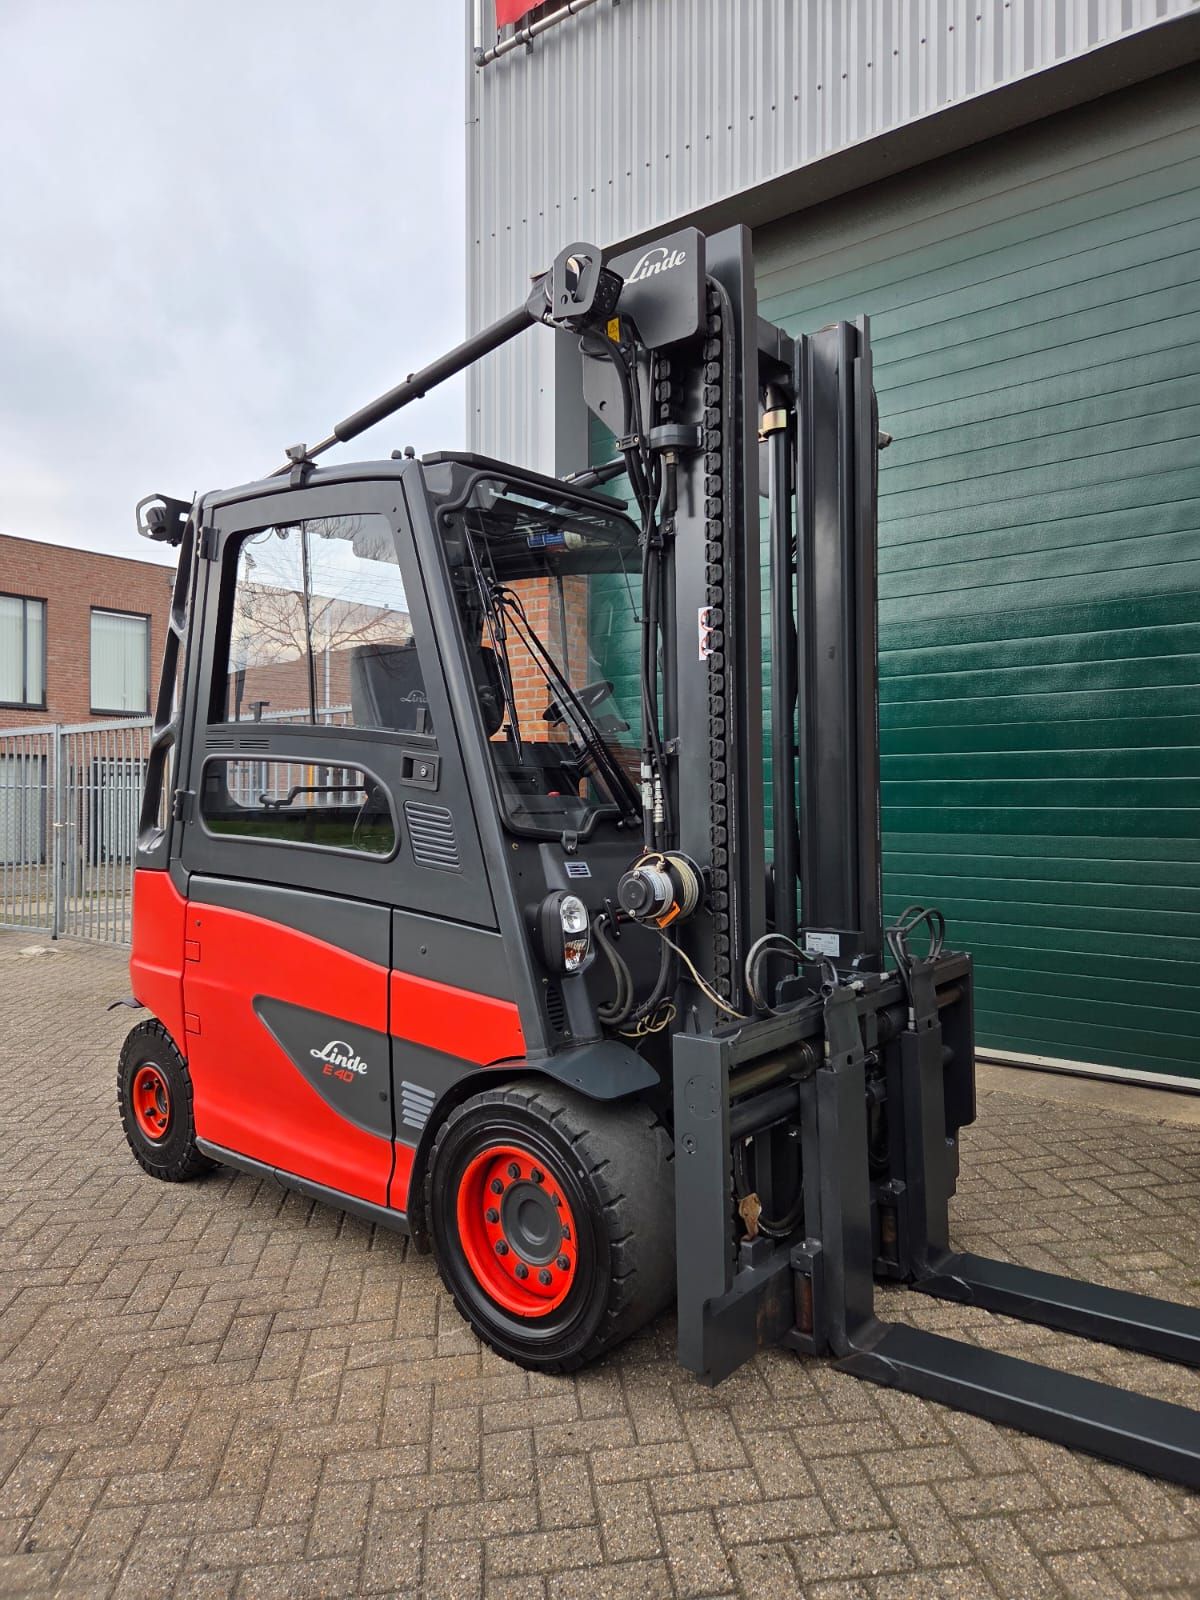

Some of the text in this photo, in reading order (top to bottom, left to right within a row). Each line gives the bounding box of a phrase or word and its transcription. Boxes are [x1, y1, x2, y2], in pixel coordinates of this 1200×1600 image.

[623, 247, 686, 287] Linde
[400, 689, 427, 703] Lin
[310, 1040, 368, 1075] Linde
